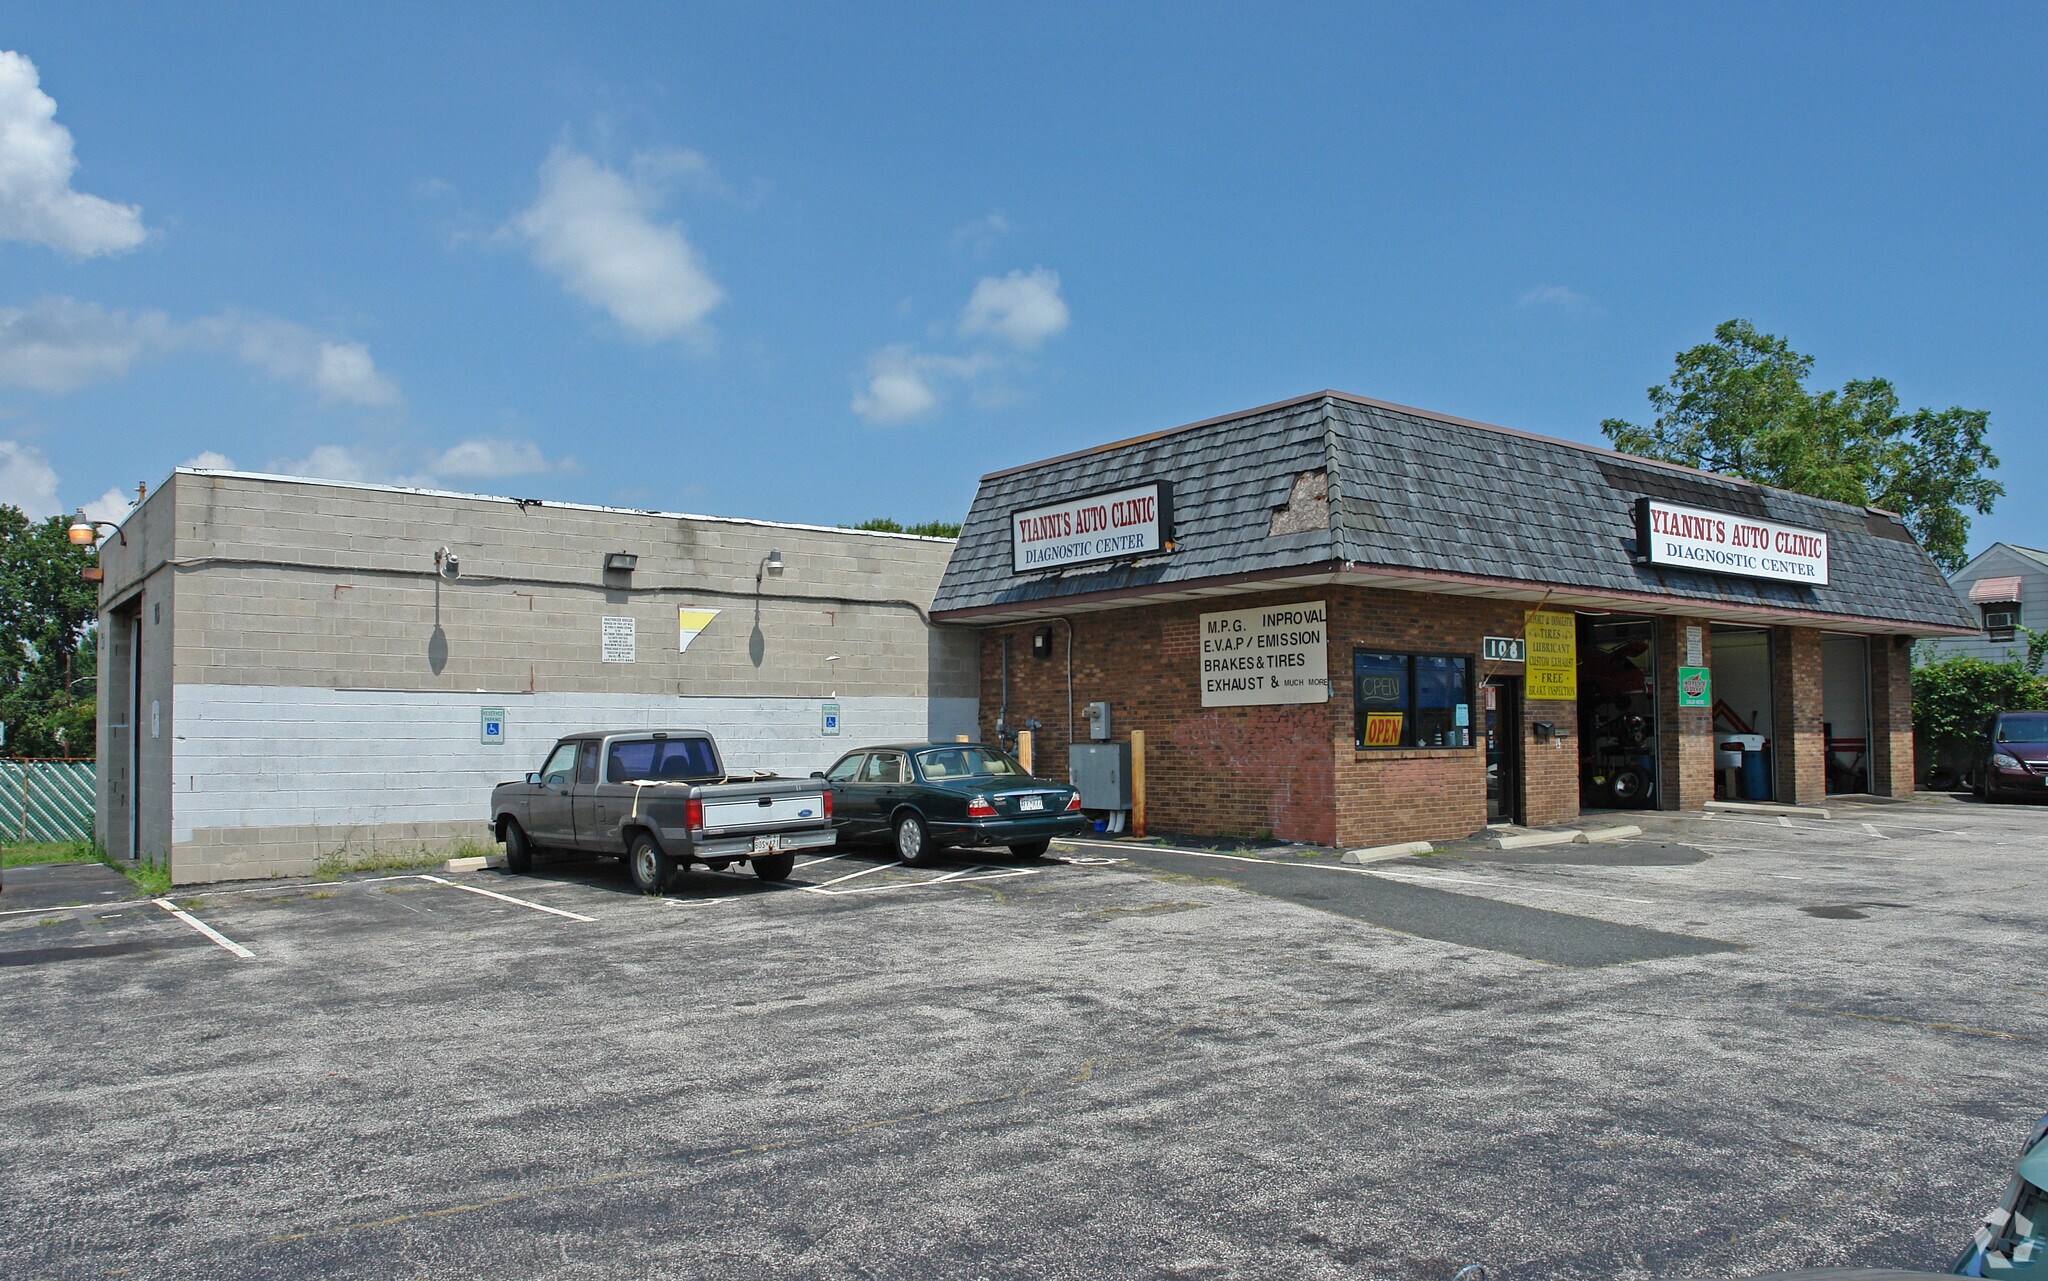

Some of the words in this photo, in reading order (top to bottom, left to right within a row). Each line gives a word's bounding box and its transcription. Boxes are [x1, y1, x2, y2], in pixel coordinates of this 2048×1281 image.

[1019, 511, 1071, 543] YIANNI'S
[1075, 504, 1107, 535] AUTO
[1111, 496, 1155, 528] CLINIC
[1650, 508, 1725, 544] YIANNI'S
[1732, 523, 1769, 550] AUTO
[1775, 531, 1822, 559] CLINIC
[1025, 541, 1092, 564] DIAGNOSTIC
[1095, 533, 1145, 554] CENTER
[1666, 542, 1757, 569] DIAGNOSTIC
[1761, 557, 1816, 577] CENTER
[1207, 619, 1246, 634] M.P.G.
[1262, 609, 1327, 627] INPROVAL
[1257, 630, 1320, 648] EMISSION
[1540, 628, 1560, 639] TIRES
[1532, 641, 1570, 654] LUBRICANT
[1267, 653, 1305, 668] TIRES
[1207, 676, 1264, 692] EXHAUST
[1270, 675, 1280, 688] &
[1284, 679, 1304, 687] MUCH
[1308, 678, 1328, 686] MORE
[1362, 677, 1399, 695] OPEN
[1541, 672, 1563, 683] FREE
[1368, 718, 1401, 743] OPEN
